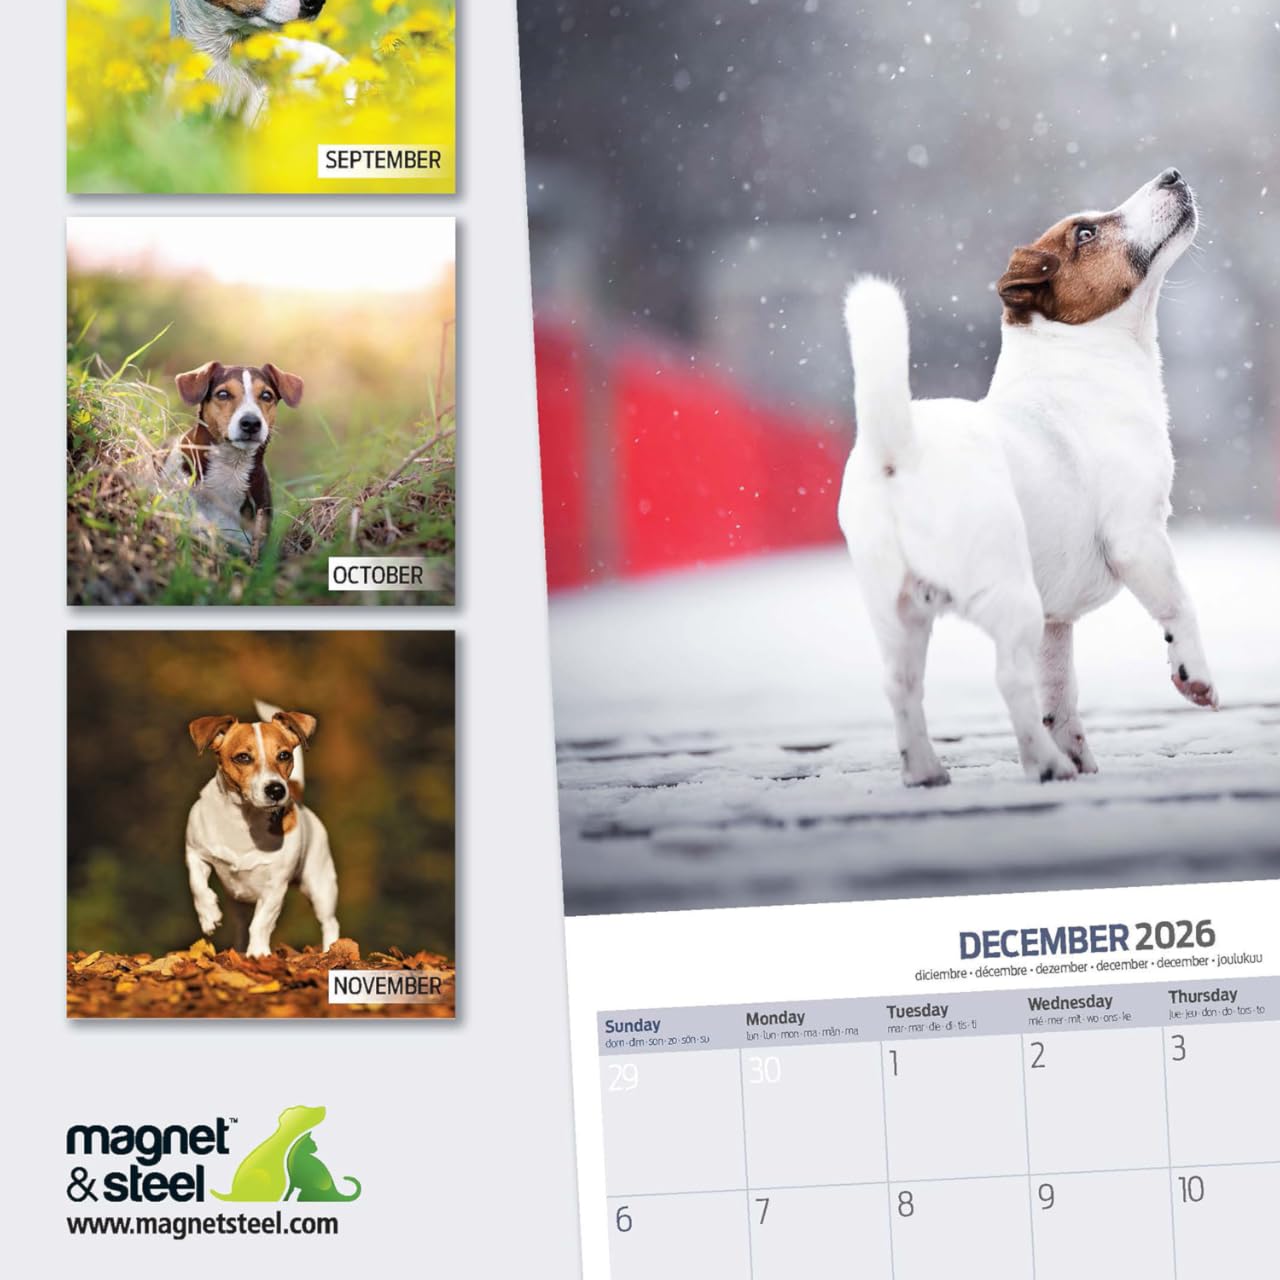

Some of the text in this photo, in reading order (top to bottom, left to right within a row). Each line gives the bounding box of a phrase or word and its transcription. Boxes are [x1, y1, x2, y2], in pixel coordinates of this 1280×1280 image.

[326, 151, 441, 168] SEPTEMBER
[332, 565, 424, 584] OCTOBER
[960, 919, 1215, 961] DECEMBER 2026
[334, 976, 441, 995] NOVEMBER
[915, 953, 1262, 981] diciembre décembre dezember december december joulukuu
[605, 1018, 660, 1033] Sunday
[747, 1010, 805, 1026] Monday
[886, 1003, 948, 1019] Tuesday
[1028, 994, 1112, 1011] Wednesday
[1168, 988, 1239, 1004] Thursday
[608, 1064, 638, 1091] 29
[749, 1056, 781, 1083] 30
[889, 1050, 897, 1076] 1
[1031, 1042, 1045, 1068] 2
[1172, 1035, 1185, 1061] 3
[67, 1117, 229, 1166] magnet
[67, 1165, 204, 1202] & steel
[616, 1206, 632, 1232] 6
[756, 1198, 769, 1224] 7
[898, 1191, 914, 1217] 8
[1039, 1184, 1054, 1210] 9
[1178, 1176, 1204, 1202] 10
[67, 1211, 338, 1240] www.magnetsteel.com
